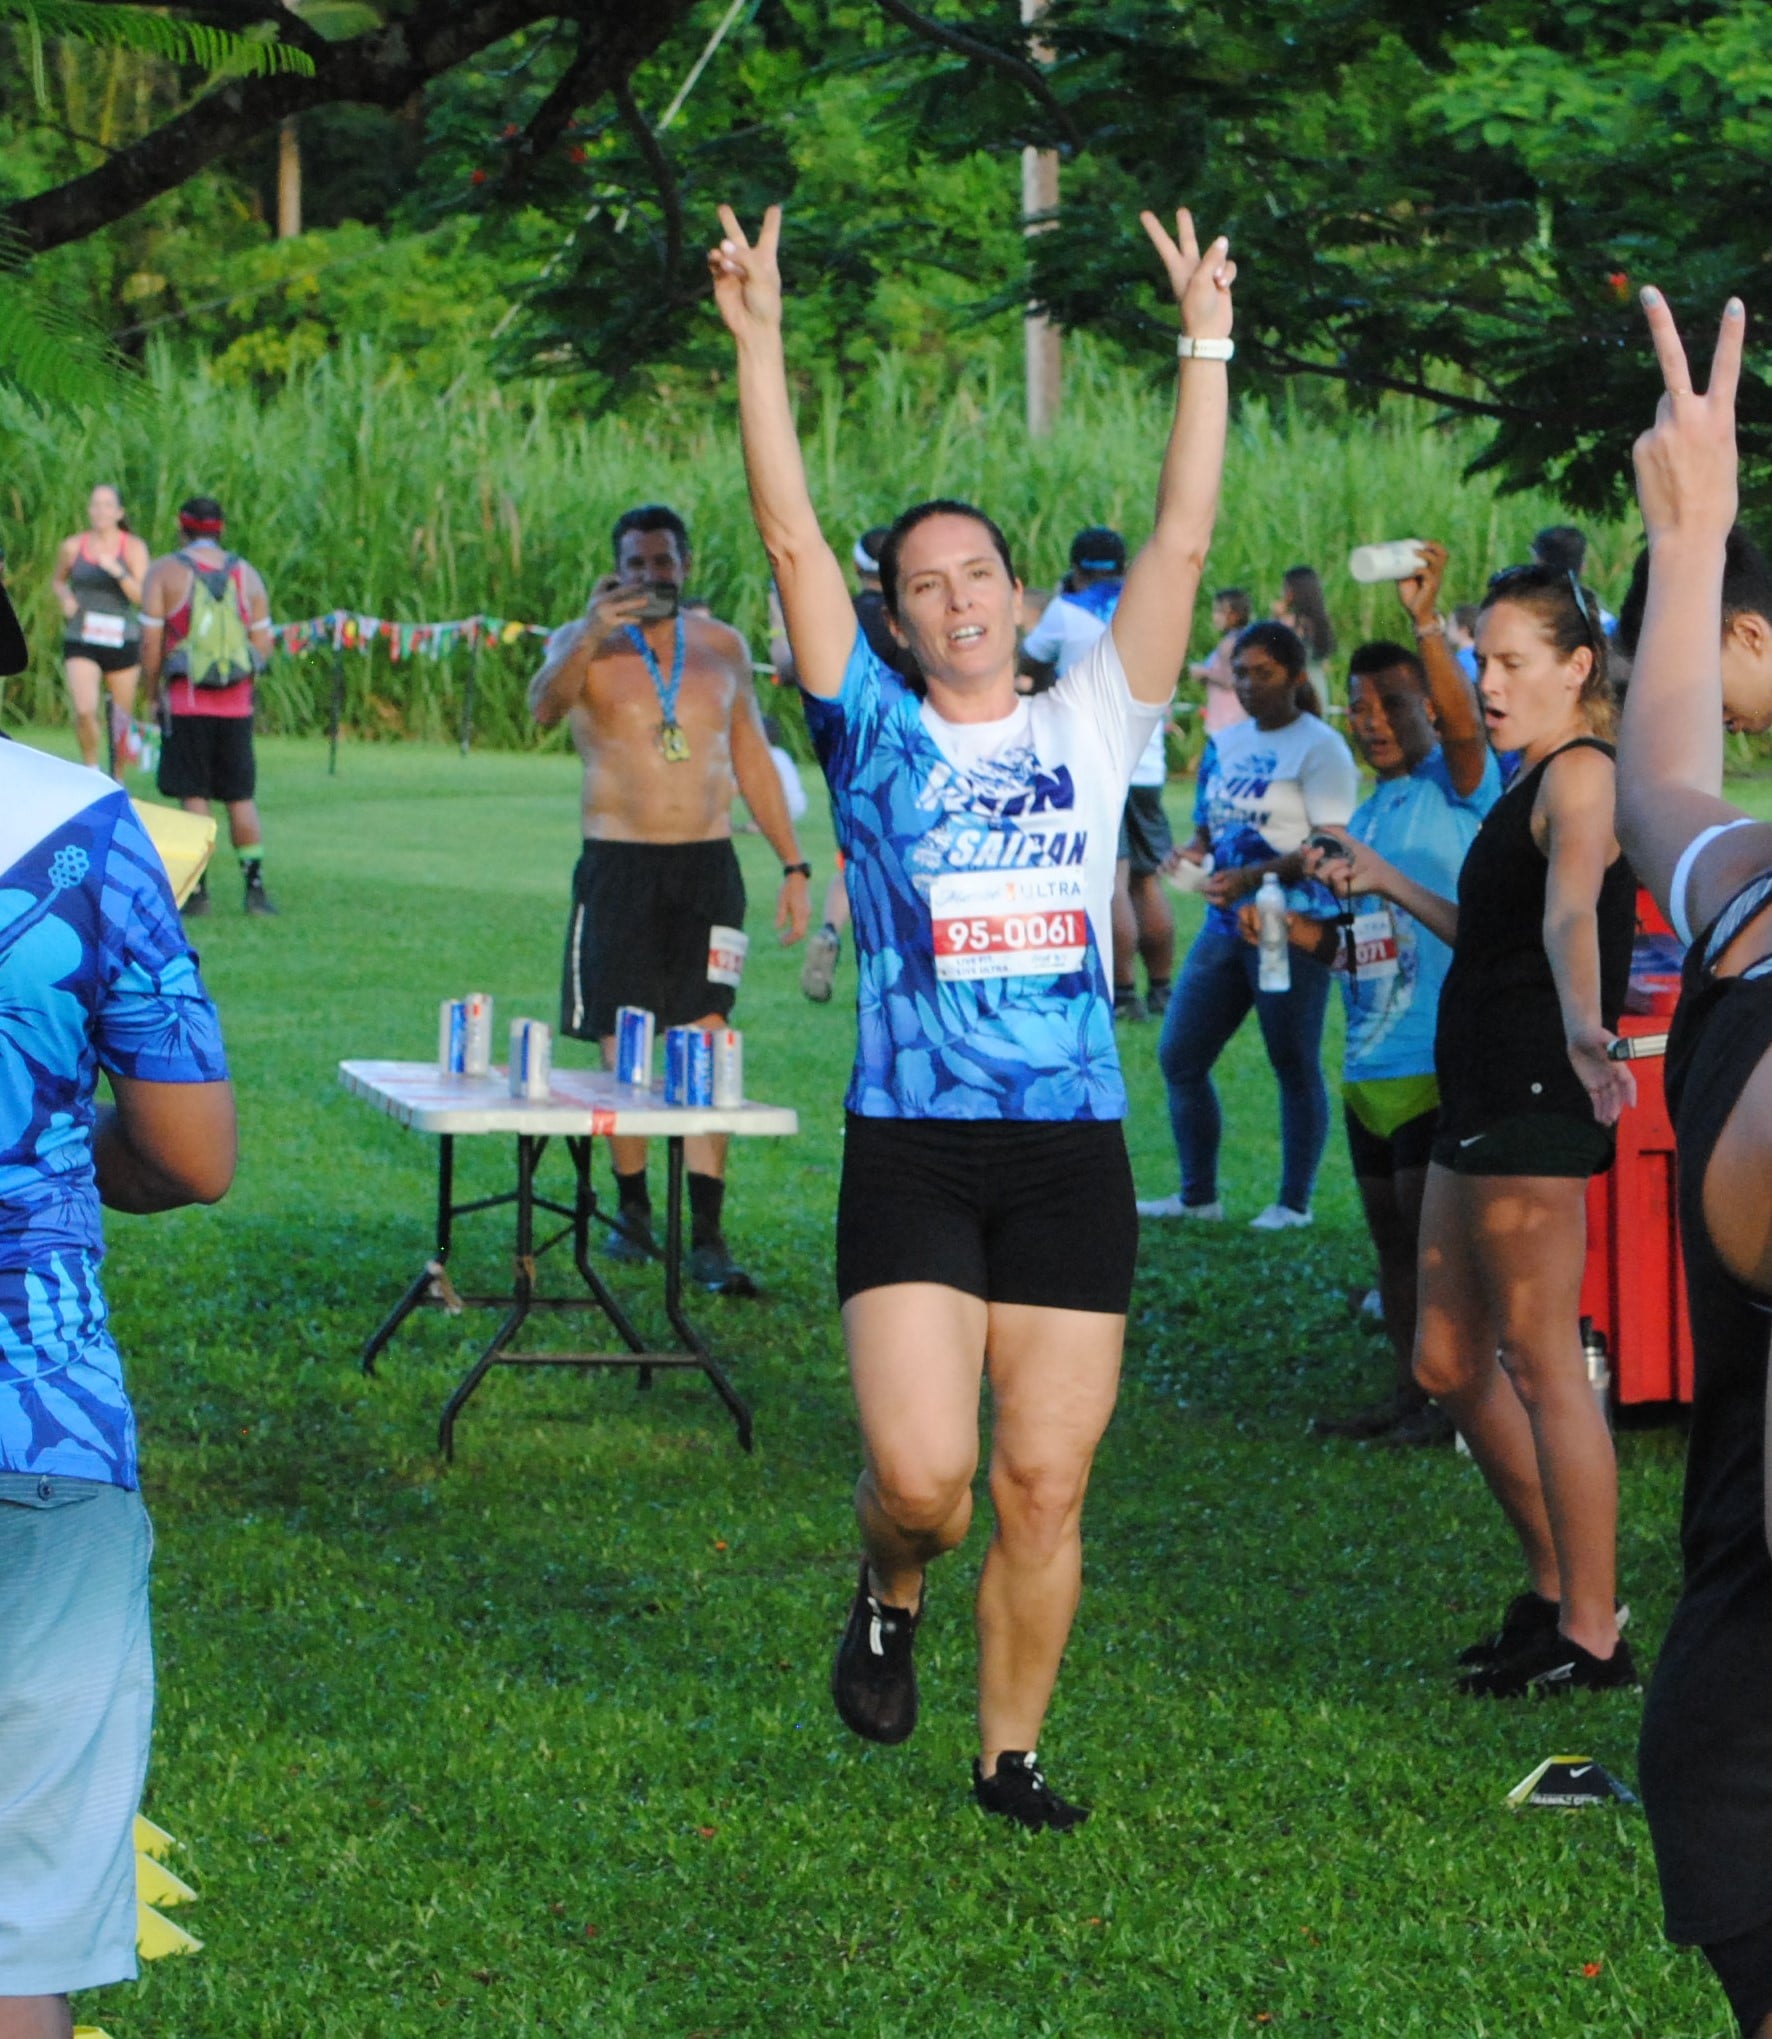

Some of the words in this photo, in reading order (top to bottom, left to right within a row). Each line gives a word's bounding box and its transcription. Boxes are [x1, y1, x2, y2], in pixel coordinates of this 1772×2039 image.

[949, 829, 1088, 868] SAIPAN
[947, 913, 1076, 951] 95-0061
[1354, 941, 1387, 965] 071
